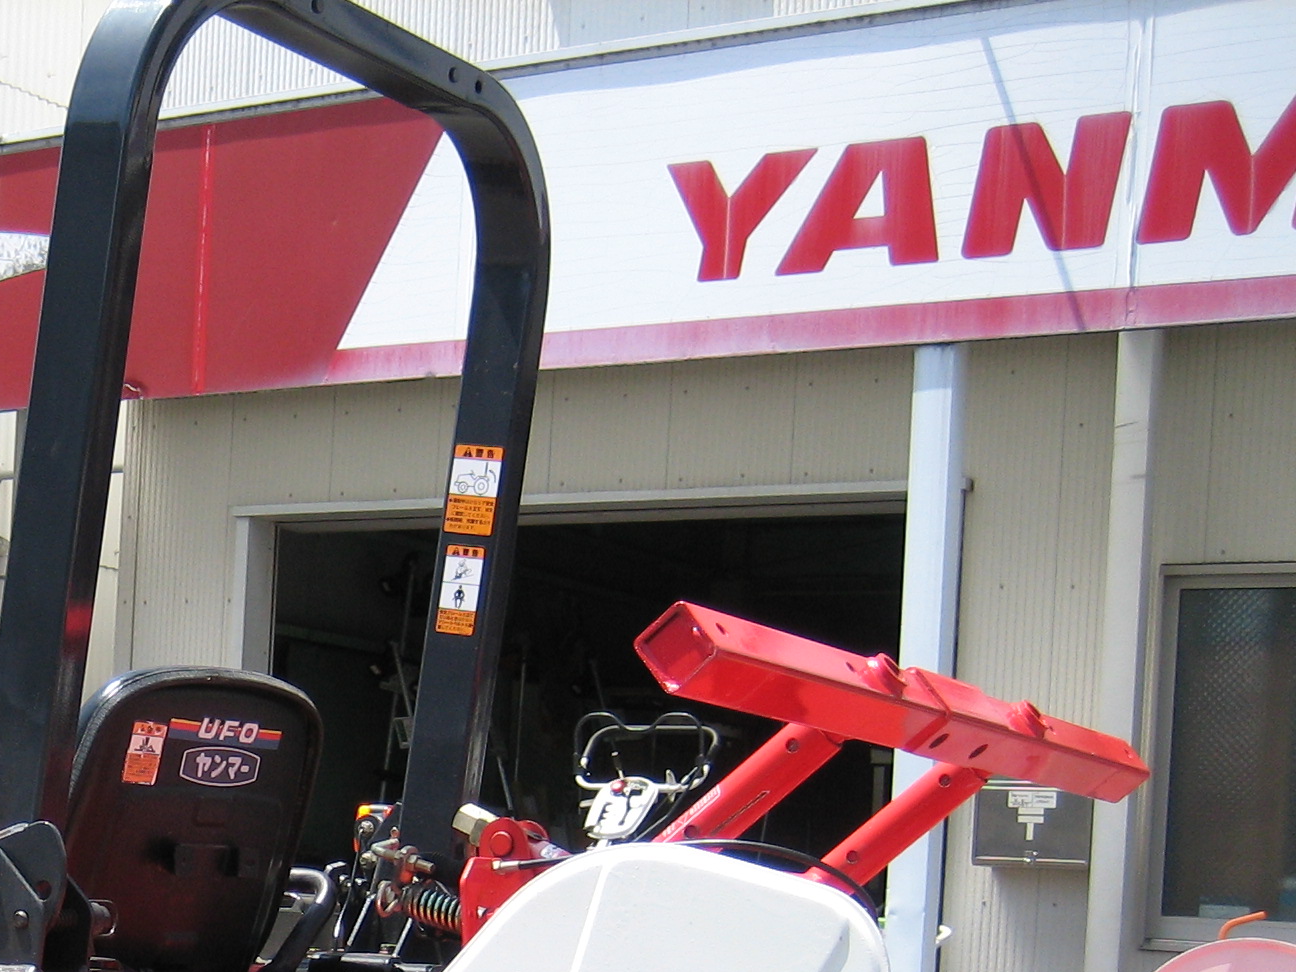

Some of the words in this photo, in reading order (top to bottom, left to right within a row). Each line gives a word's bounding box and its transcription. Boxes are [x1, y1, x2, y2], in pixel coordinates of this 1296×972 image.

[198, 717, 259, 744] UFO
[196, 753, 250, 779] ヤンマー
